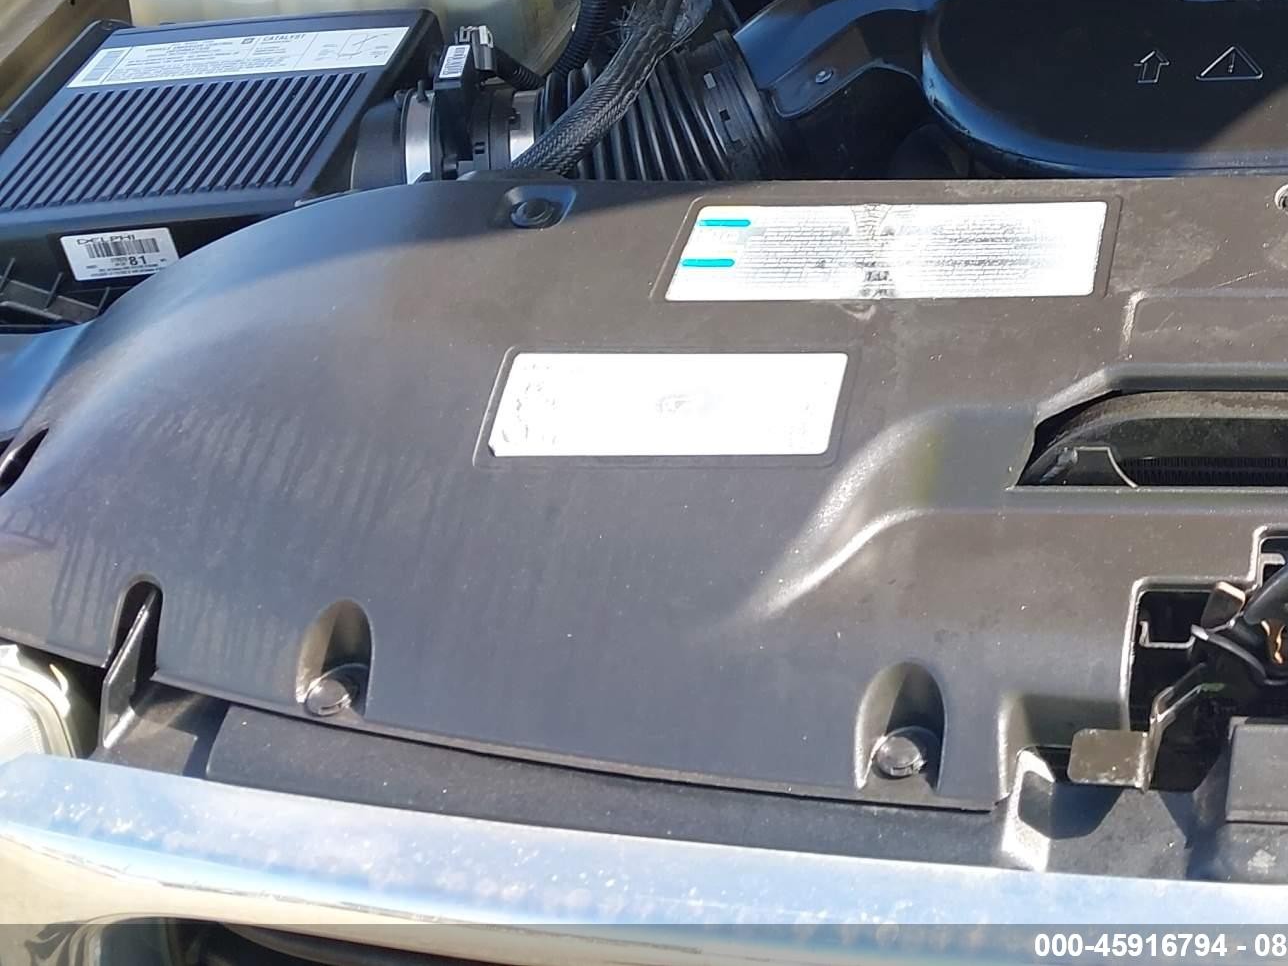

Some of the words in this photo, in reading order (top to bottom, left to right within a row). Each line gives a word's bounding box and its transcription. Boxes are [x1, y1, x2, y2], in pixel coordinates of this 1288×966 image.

[262, 33, 306, 42] CATALYST
[77, 234, 136, 246] DELPHI
[128, 256, 147, 266] 81
